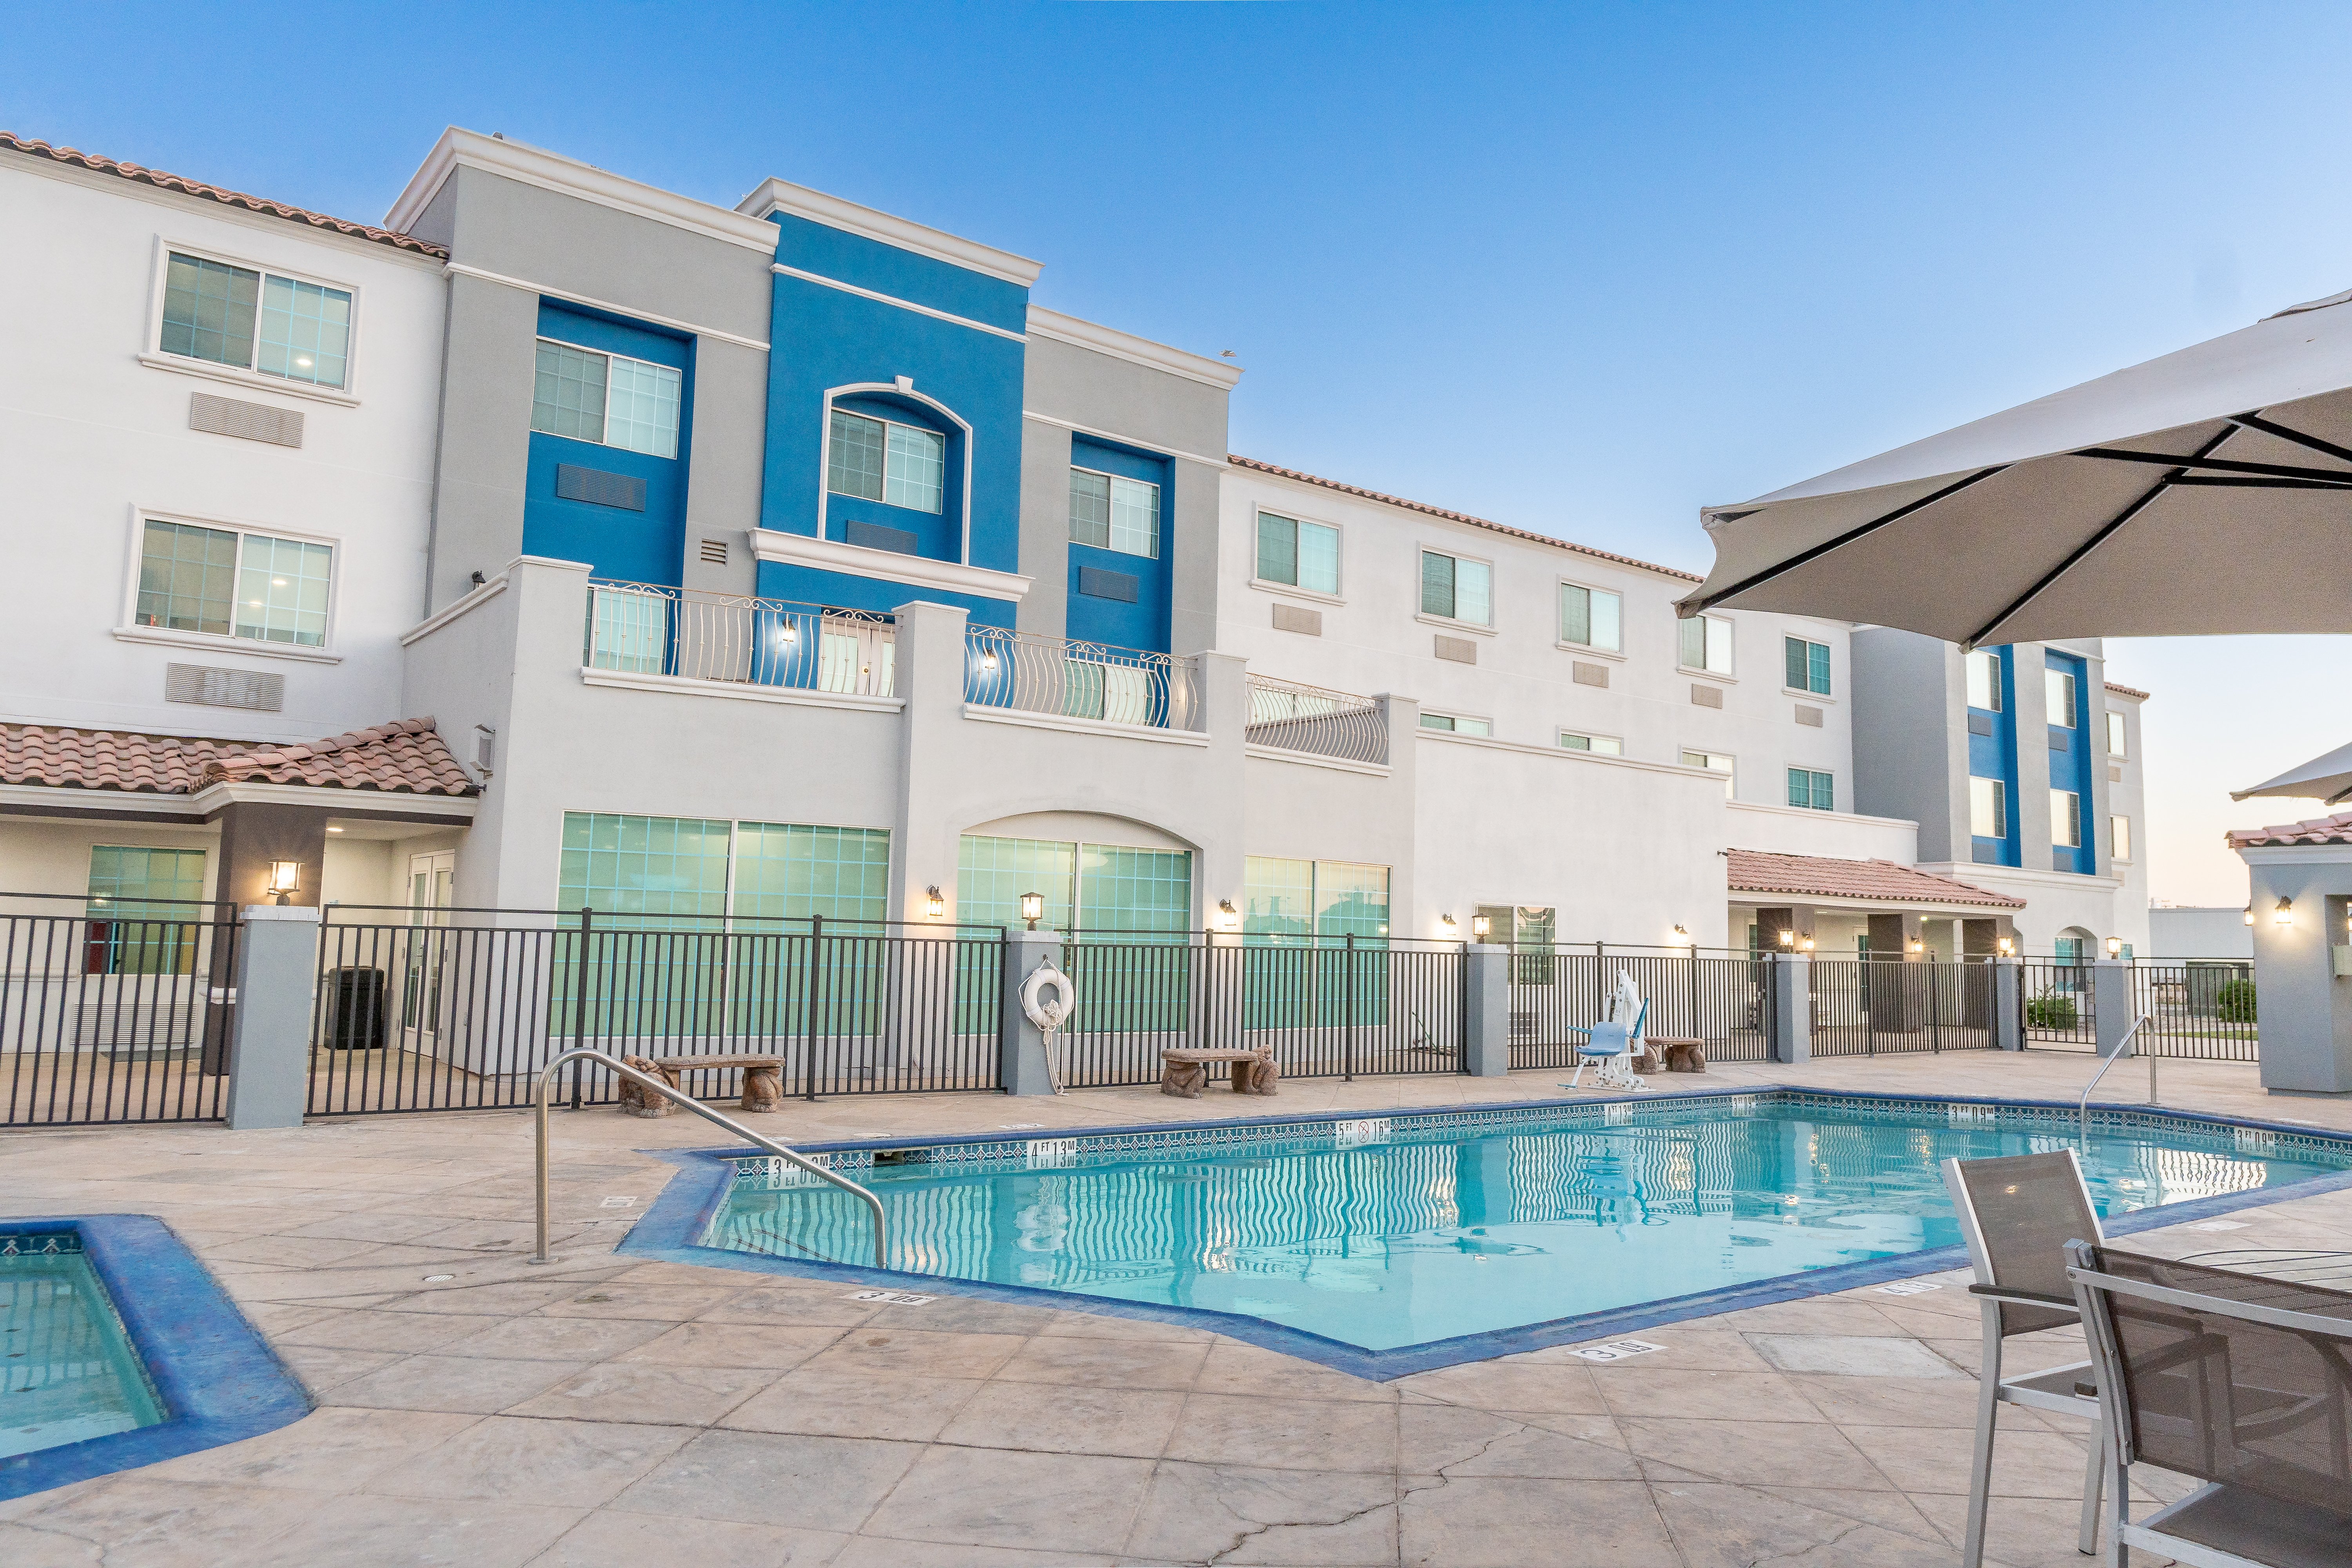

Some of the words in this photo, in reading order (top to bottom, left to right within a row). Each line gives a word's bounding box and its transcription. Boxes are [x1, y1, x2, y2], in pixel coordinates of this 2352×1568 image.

[1339, 1123, 1344, 1135] 5
[1346, 1123, 1352, 1131] FT
[1041, 1142, 1049, 1152] FT
[774, 1159, 781, 1174] 3
[1580, 1350, 1617, 1358] 3
